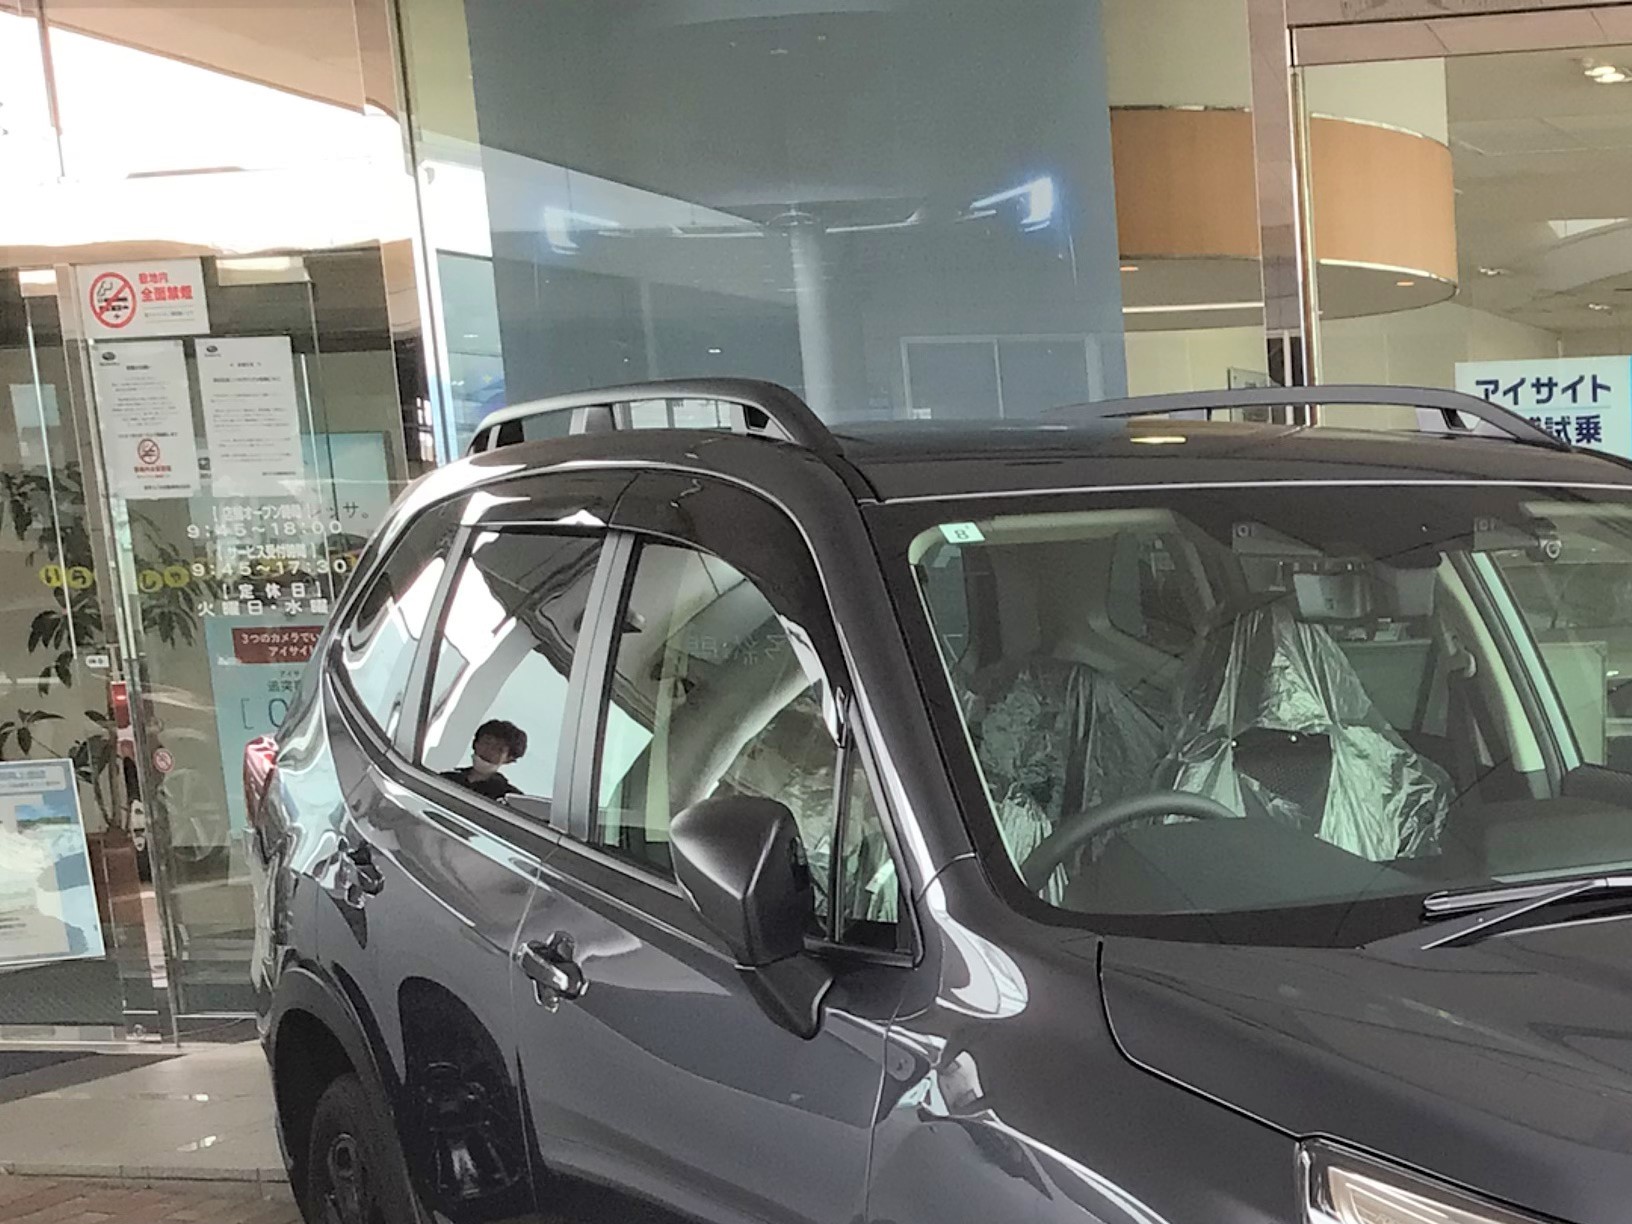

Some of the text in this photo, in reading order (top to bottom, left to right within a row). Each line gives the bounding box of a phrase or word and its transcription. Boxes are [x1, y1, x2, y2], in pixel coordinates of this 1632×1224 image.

[1475, 374, 1611, 405] アイサイト
[1528, 414, 1602, 444] 試乗
